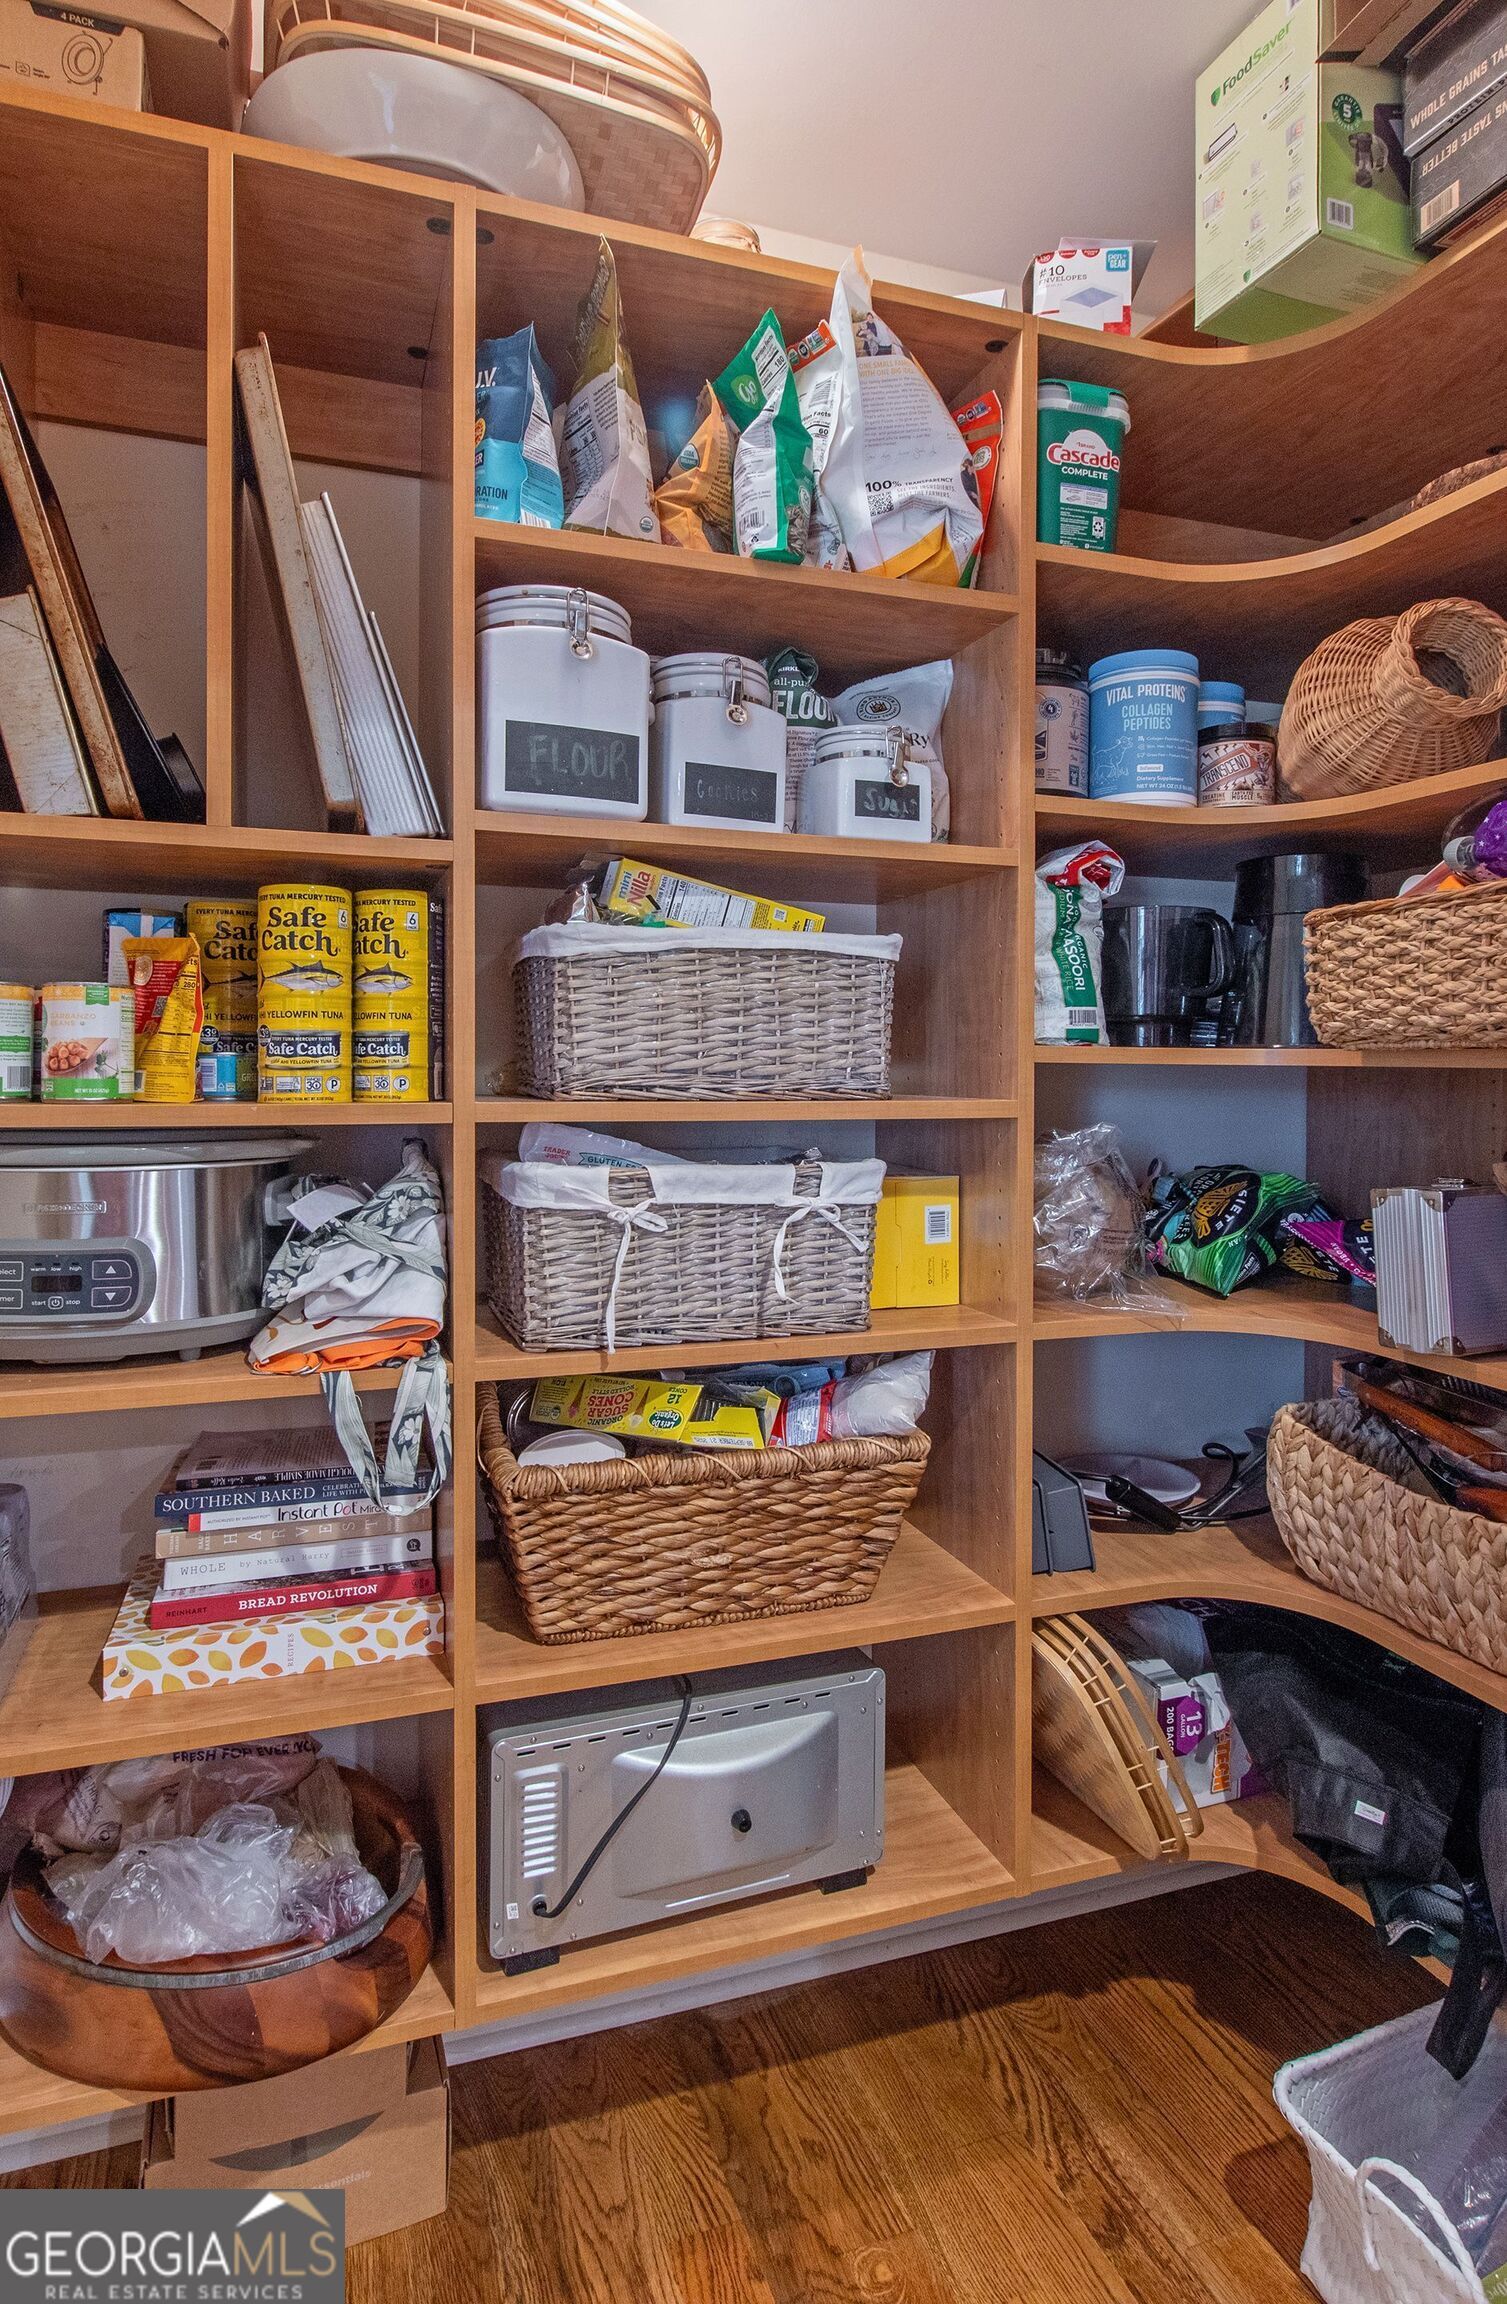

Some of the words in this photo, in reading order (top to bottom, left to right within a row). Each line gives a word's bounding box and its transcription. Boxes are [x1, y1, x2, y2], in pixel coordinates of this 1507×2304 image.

[60, 12, 67, 20] 4
[69, 14, 95, 28] PACK
[1223, 18, 1294, 96] FoodSaver
[1411, 92, 1446, 129] WHOLE
[1449, 59, 1488, 99] GRAINS
[1343, 104, 1352, 118] 5
[1461, 112, 1492, 147] TASTE
[1422, 139, 1458, 177] BETTER
[1048, 444, 1120, 471] Cascade
[1061, 466, 1109, 480] COMPLETE
[866, 480, 902, 492] 100%
[905, 477, 953, 486] TRANSPARENCY
[1106, 686, 1134, 707] VITAL
[1137, 683, 1186, 703] PROTEINS
[1122, 703, 1173, 718] COLLAGEN
[1123, 717, 1171, 731] PEPTIDES
[529, 734, 632, 785] FLOUR
[1203, 753, 1249, 787] TRANSCEND
[619, 871, 632, 899] mini
[627, 871, 651, 907] Nilla
[679, 881, 687, 891] 140
[323, 895, 346, 903] TESTED
[392, 899, 416, 907] TESTED
[267, 906, 326, 928] Safe
[341, 911, 347, 923] 6
[409, 913, 416, 925] 6
[262, 929, 339, 957] Catch
[267, 1010, 318, 1019] YELLOWFIN
[321, 1011, 344, 1019] TUNA
[389, 1012, 412, 1020] TUNA
[216, 1041, 243, 1052] Safe
[268, 1042, 294, 1055] Safe
[296, 1042, 339, 1056] Catch
[367, 1042, 407, 1056] Catch
[331, 1079, 338, 1089] P
[400, 1079, 407, 1088] P
[588, 1156, 622, 1167] GLUTEN
[1215, 1190, 1247, 1231] SIETE
[587, 1391, 634, 1407] CONES
[667, 1392, 682, 1404] 12
[587, 1404, 629, 1419] SUGAR
[654, 1409, 681, 1421] Organic
[587, 1414, 624, 1426] ORGANIC
[651, 1418, 661, 1428] Do
[661, 1418, 676, 1430] Let's
[274, 1472, 302, 1482] SIMPLE
[304, 1470, 325, 1480] MADE
[162, 1491, 256, 1512] SOUTHERN
[261, 1486, 316, 1503] BAKED
[322, 1490, 338, 1498] LIFE
[339, 1489, 357, 1497] WITH
[278, 1503, 328, 1521] Instant
[334, 1501, 356, 1516] Pot
[224, 1519, 377, 1545] HARVEST
[180, 1562, 226, 1576] WHOLE
[239, 1560, 251, 1568] by
[257, 1554, 296, 1566] Natural
[302, 1551, 330, 1562] Harry
[166, 1607, 208, 1617] REINHART
[239, 1595, 287, 1611] BREAD
[290, 1583, 379, 1604] REVOLUTION
[1167, 1706, 1175, 1724] 200
[1186, 1711, 1203, 1737] 13
[173, 1751, 216, 1763] FRESH
